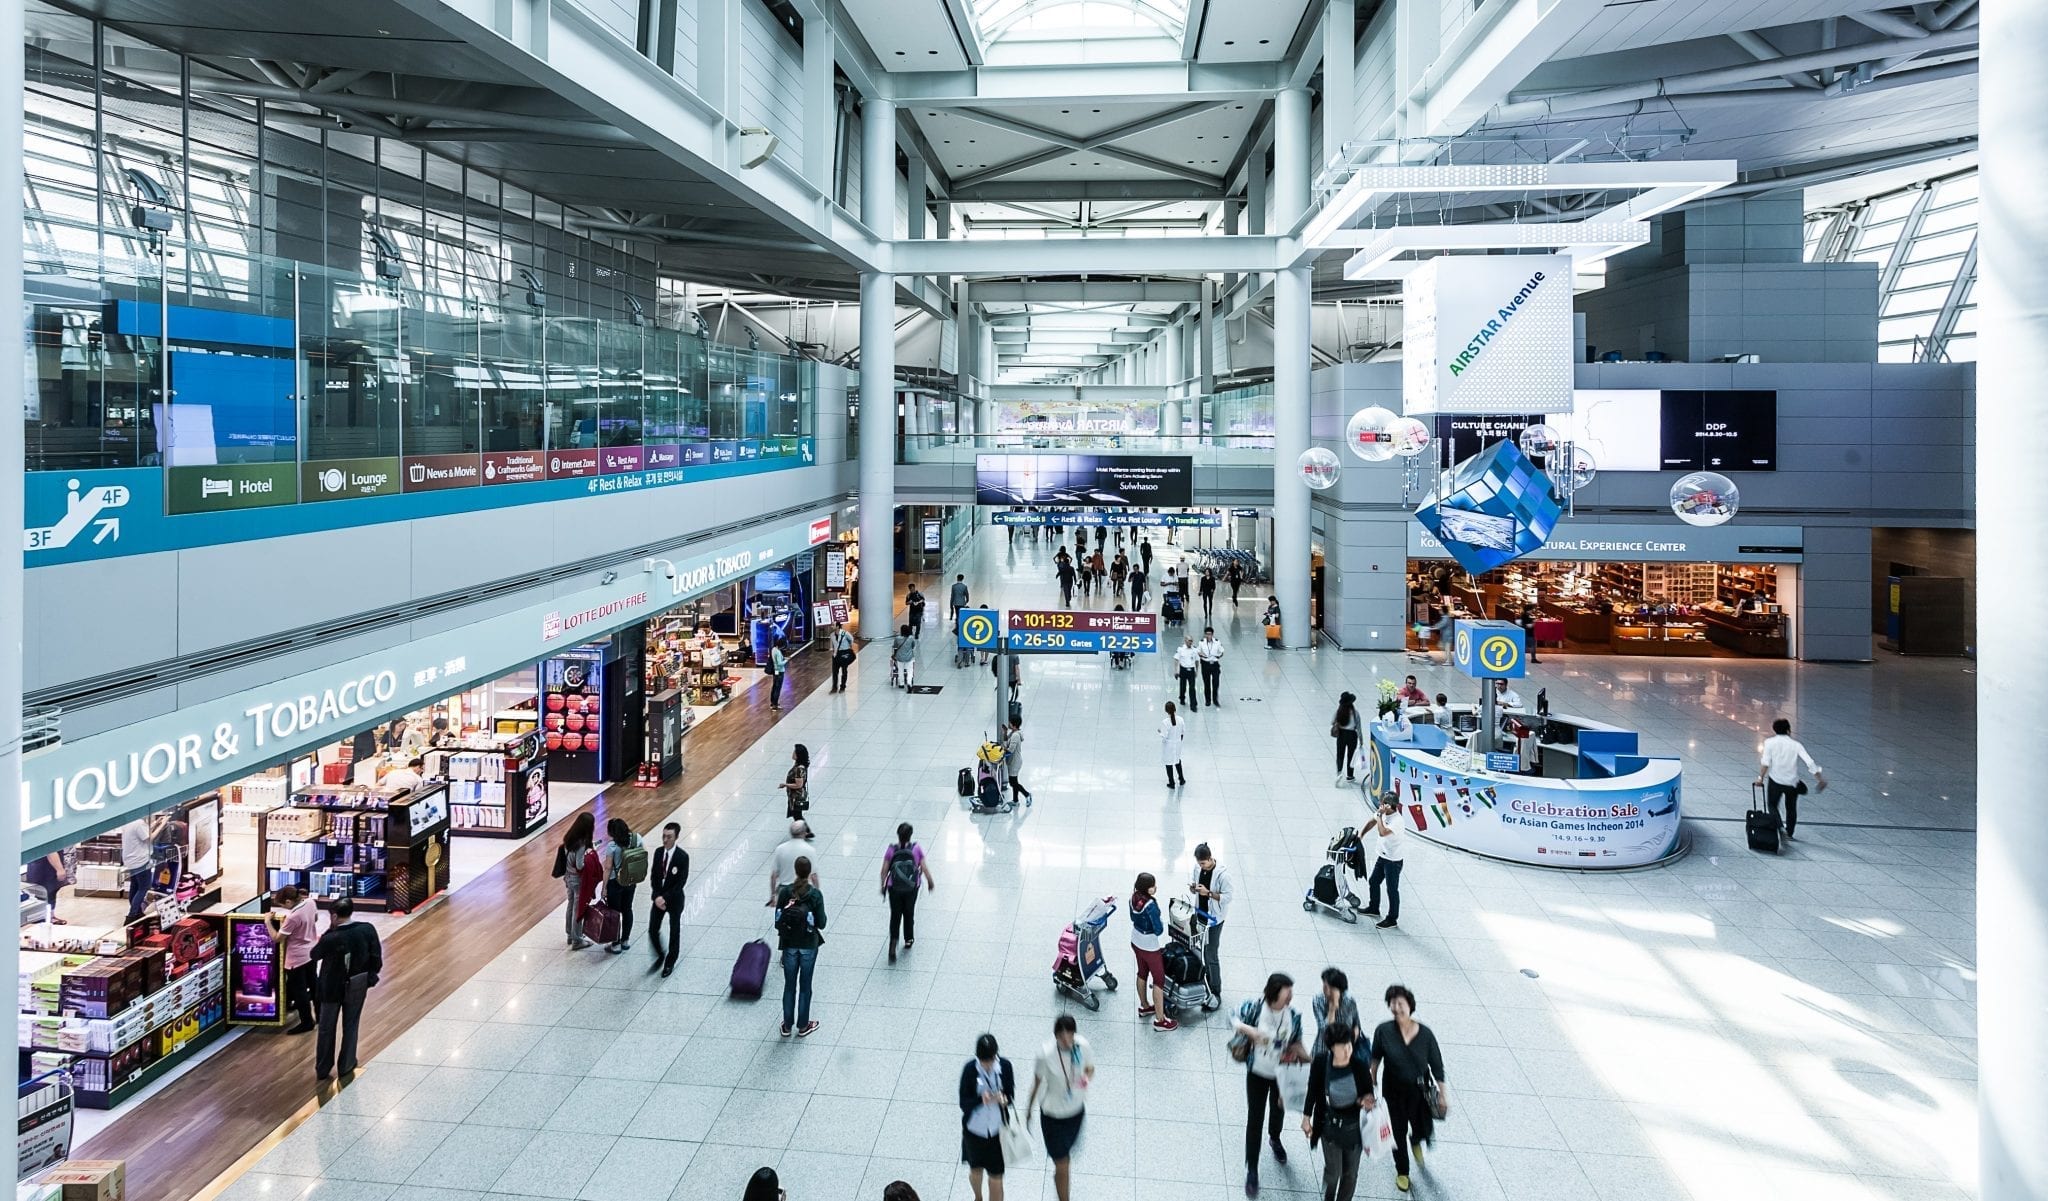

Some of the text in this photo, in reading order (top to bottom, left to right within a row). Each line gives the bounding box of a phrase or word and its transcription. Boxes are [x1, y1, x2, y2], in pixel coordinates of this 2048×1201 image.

[1449, 271, 1545, 377] AIRSTAR Avenue
[506, 455, 533, 465] Traditional
[562, 459, 596, 470] Internet Zone
[617, 455, 637, 465] Rest Area
[427, 465, 477, 479] News & Movie
[497, 464, 543, 475] Craftworks Gallery
[240, 478, 273, 494] Hotel
[352, 472, 388, 487] Lounge
[588, 479, 598, 493] 4F
[599, 478, 616, 492] Rest
[616, 476, 623, 489] &
[623, 475, 642, 488] Relax
[1119, 481, 1159, 490] Sulwhasoo
[102, 488, 121, 504] 4F
[1141, 517, 1162, 525] Lounge
[29, 530, 51, 548] 3F
[1580, 540, 1643, 551] EXPERIENCE
[1645, 541, 1686, 551] CENTER
[672, 566, 708, 595] LIQUOR
[708, 563, 715, 582] &
[715, 550, 751, 578] TOBACCO
[564, 592, 647, 630] LOTTE DUTY FREE
[1024, 613, 1074, 628] 101-132
[1024, 633, 1140, 650] 26-50 Gates 12-25
[21, 733, 203, 831] LIQUOR
[210, 722, 240, 762] &
[244, 669, 397, 748] TOBACCO
[1511, 799, 1640, 818] Celebration Sale
[1502, 813, 1644, 831] for Asian Games Incheon 2014
